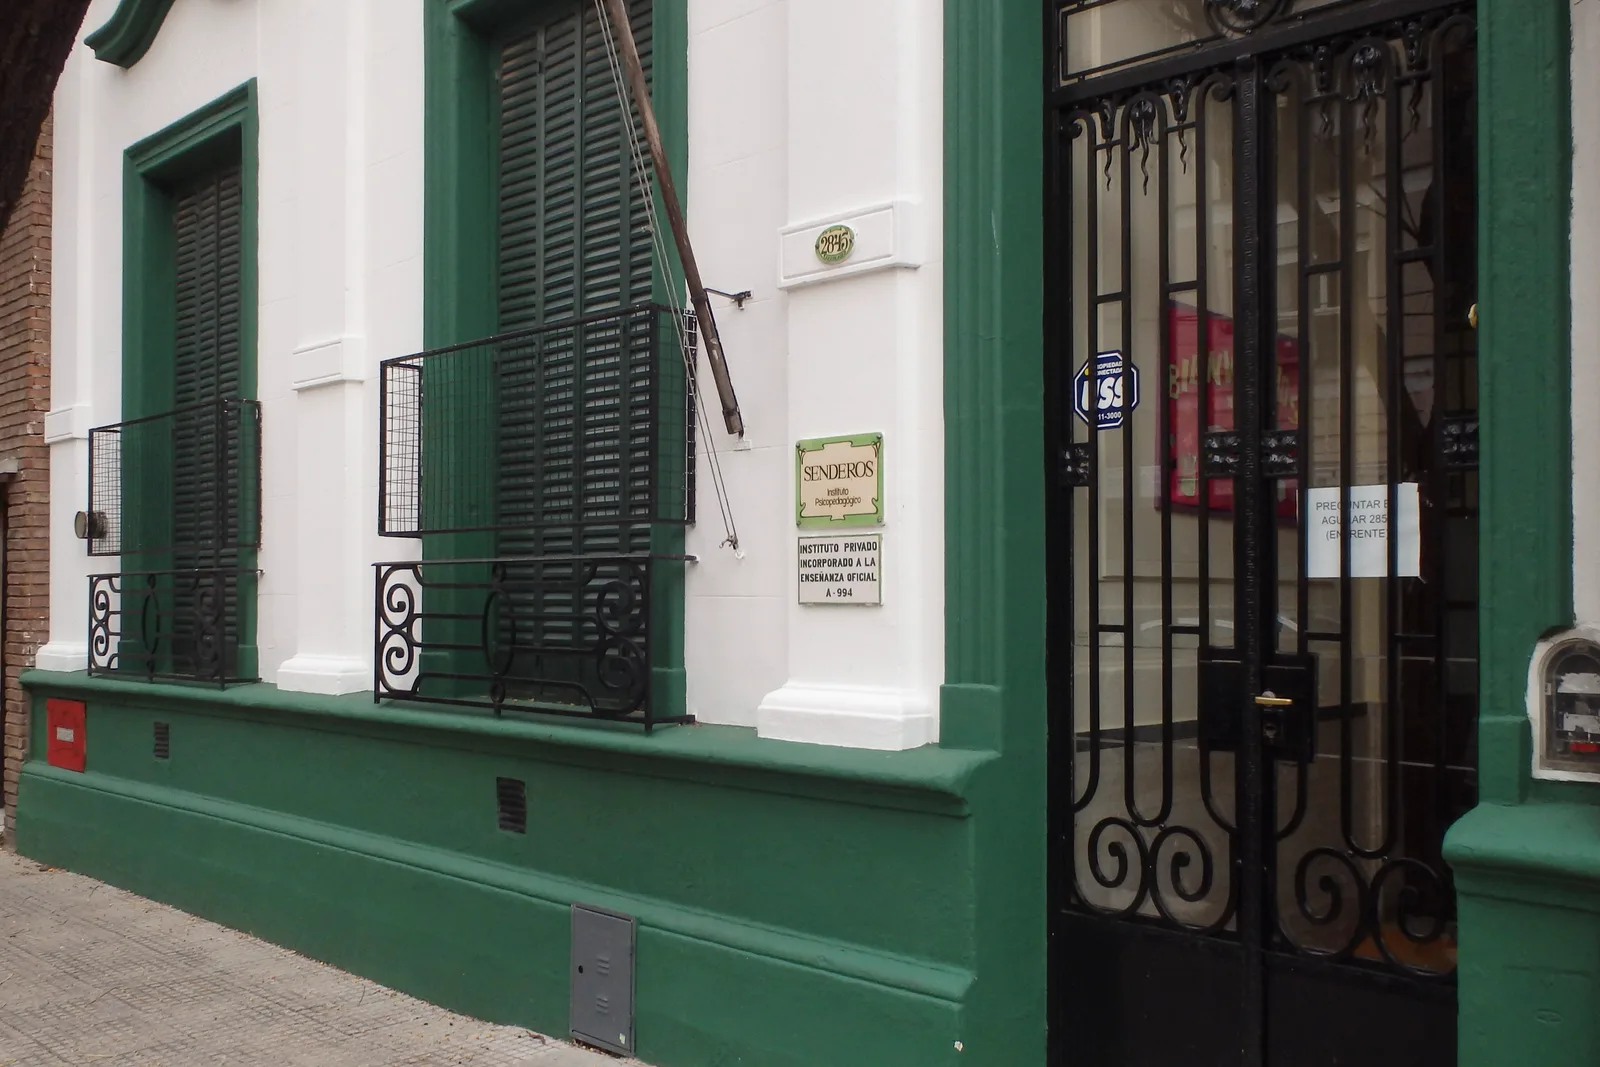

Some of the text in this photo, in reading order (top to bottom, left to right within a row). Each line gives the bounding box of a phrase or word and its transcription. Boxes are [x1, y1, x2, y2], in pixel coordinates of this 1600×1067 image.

[820, 231, 848, 254] 2845
[804, 460, 874, 481] SENDEROS
[827, 487, 849, 496] Instituto
[815, 496, 861, 507] Psicopedagógico
[1316, 500, 1380, 510] PRENTAR
[1321, 514, 1366, 525] AGUAR
[800, 541, 877, 554] INSTITUTO PRIVADO
[801, 557, 876, 568] INCORPORADO A LA
[801, 571, 876, 582] ENSEÑANZA OFICIAL
